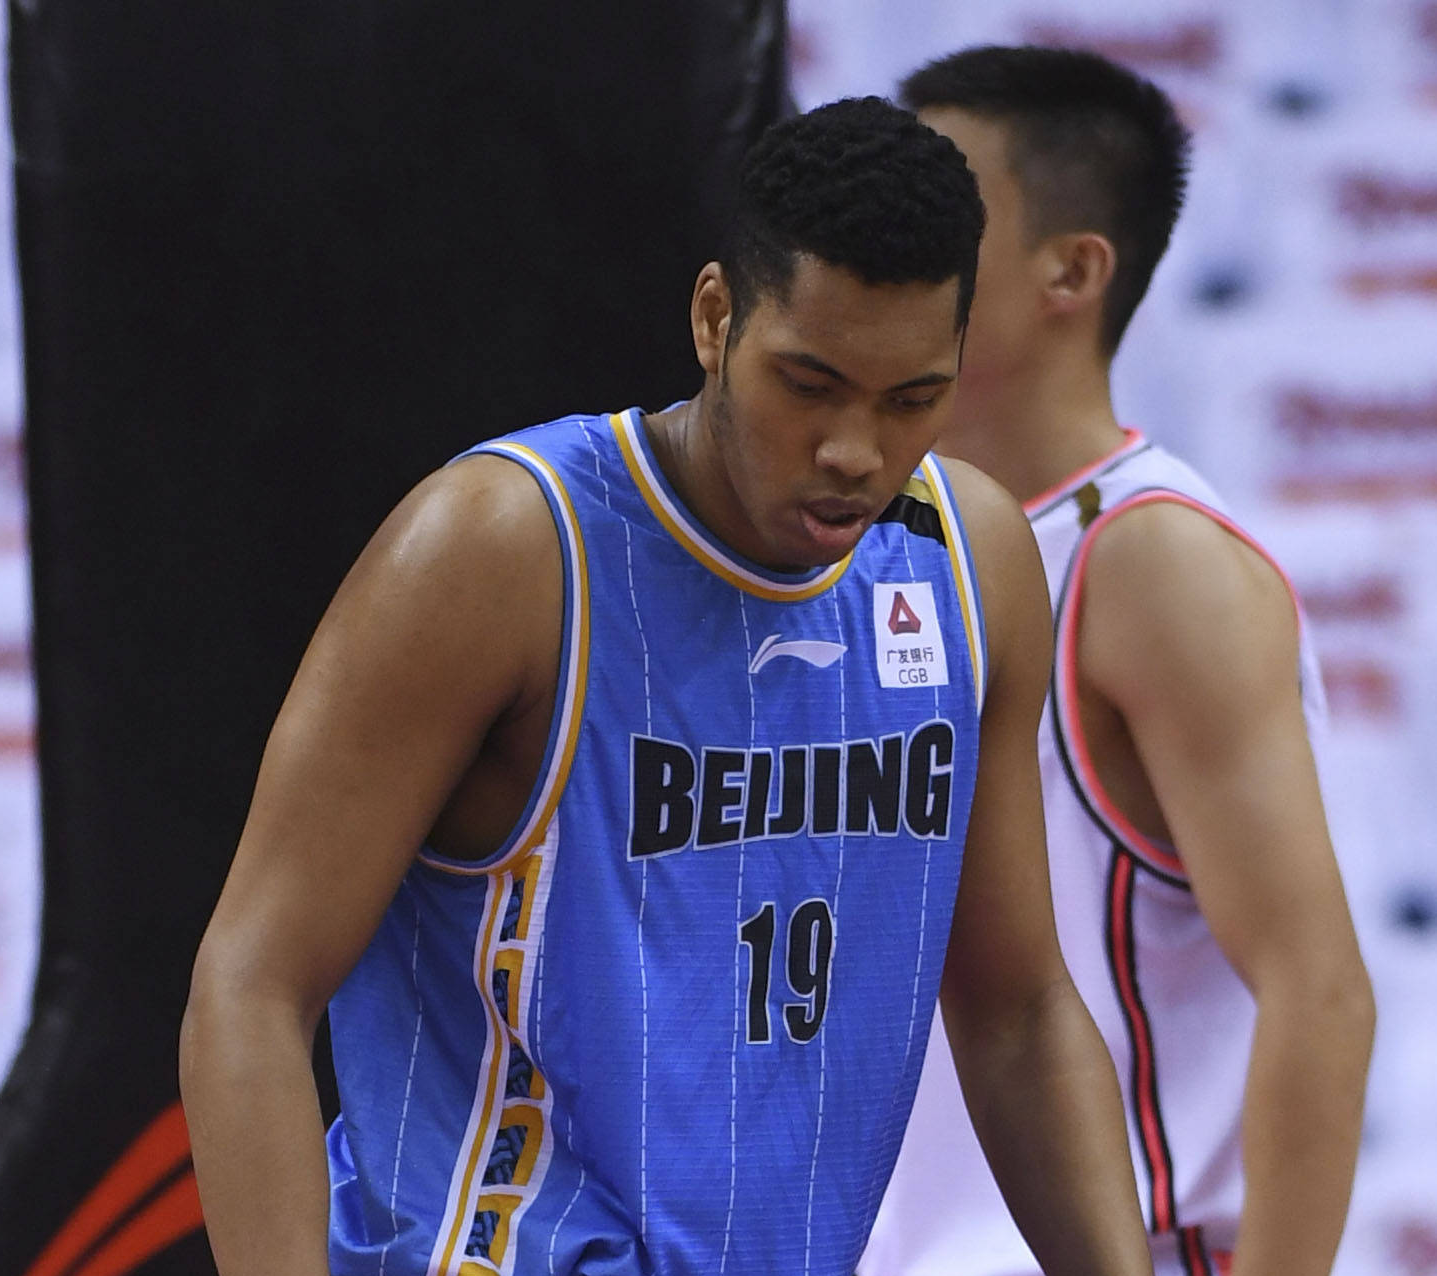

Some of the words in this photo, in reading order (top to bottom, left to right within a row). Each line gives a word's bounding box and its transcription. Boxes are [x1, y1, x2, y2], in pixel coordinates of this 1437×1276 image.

[886, 647, 934, 664] 广发银行
[898, 667, 929, 684] CGB
[627, 718, 956, 862] BEIJING
[738, 897, 836, 1045] 19
